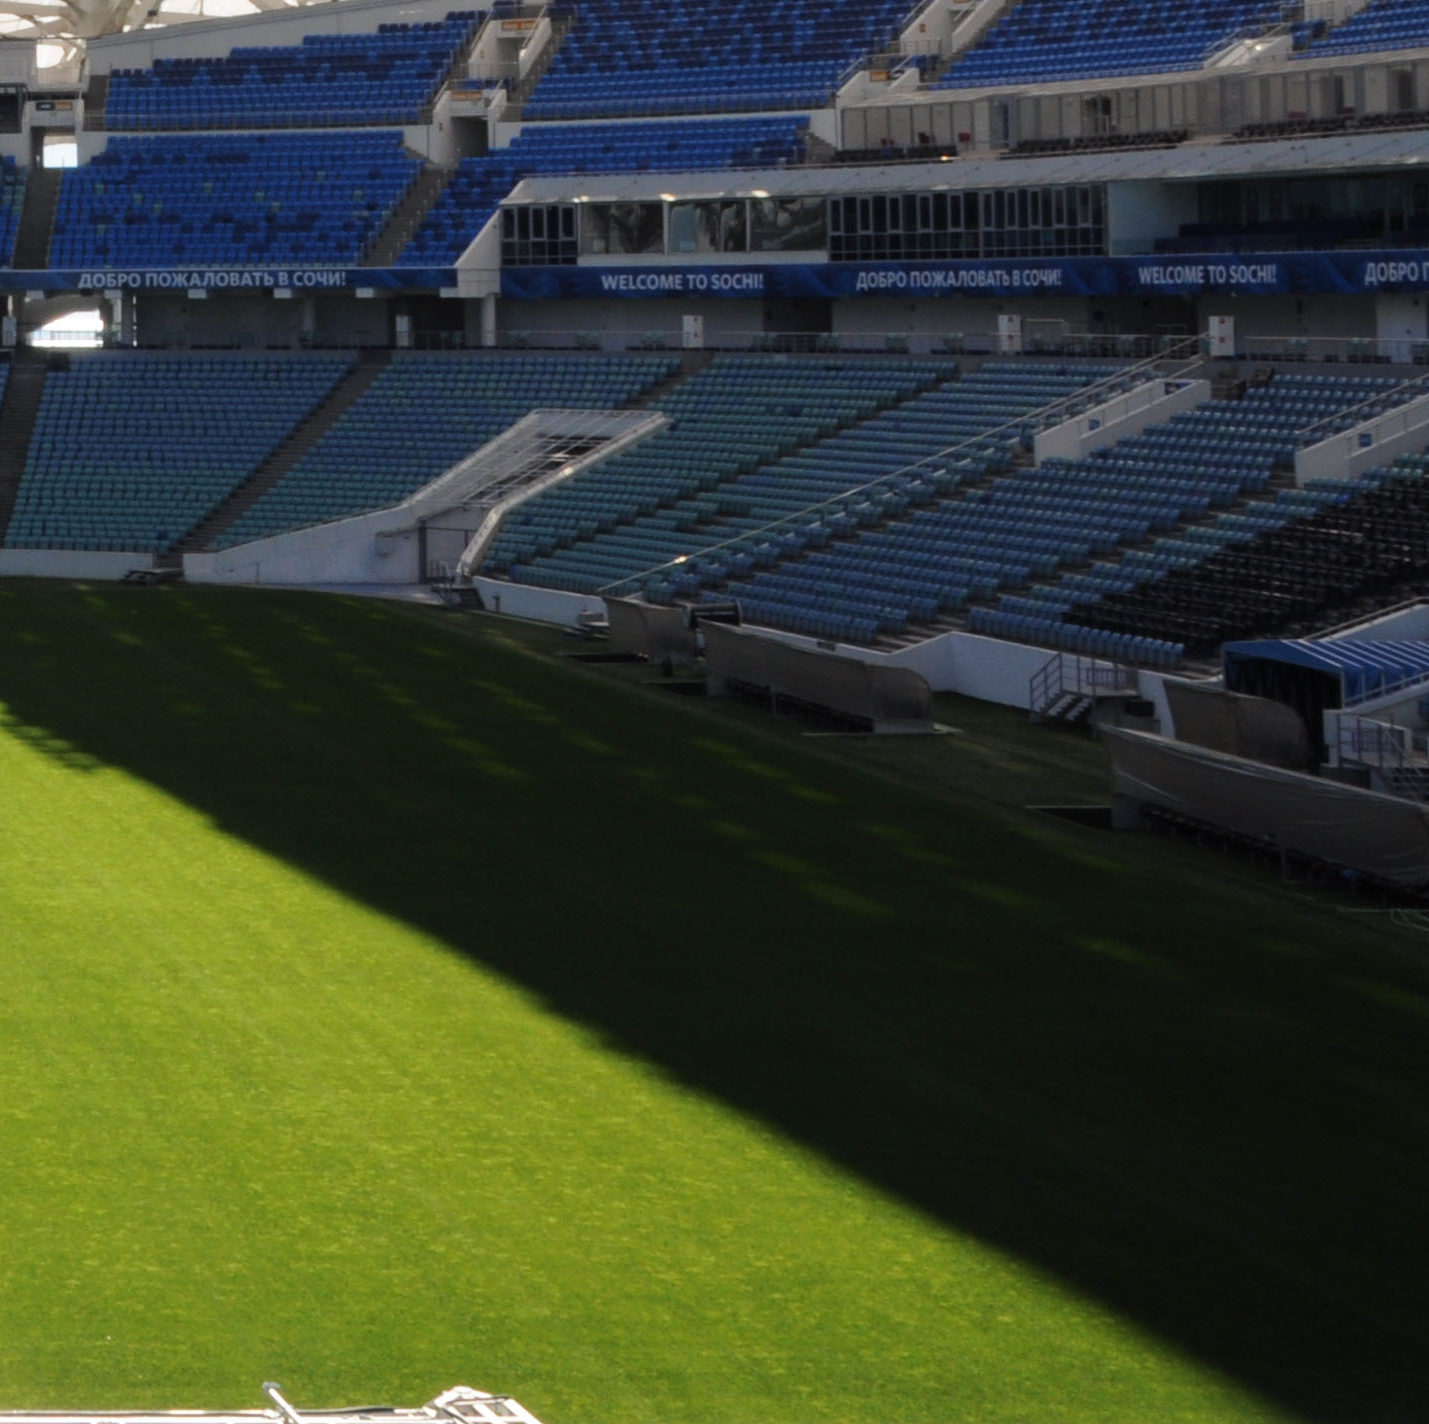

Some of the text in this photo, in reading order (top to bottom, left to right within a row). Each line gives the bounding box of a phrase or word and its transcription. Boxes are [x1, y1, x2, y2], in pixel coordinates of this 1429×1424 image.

[77, 271, 345, 288] ДОБРО ПОЖАЛОВАТЬ В СОЧИ!
[601, 273, 763, 290] WELCOME TO SOCHI!
[856, 268, 1062, 291] ДОБРО ПОЖАЛОВАТЬ В СОЧИ!
[1138, 264, 1277, 285] WELCOME TO SOCHI!
[1364, 261, 1419, 286] ДОБРО
